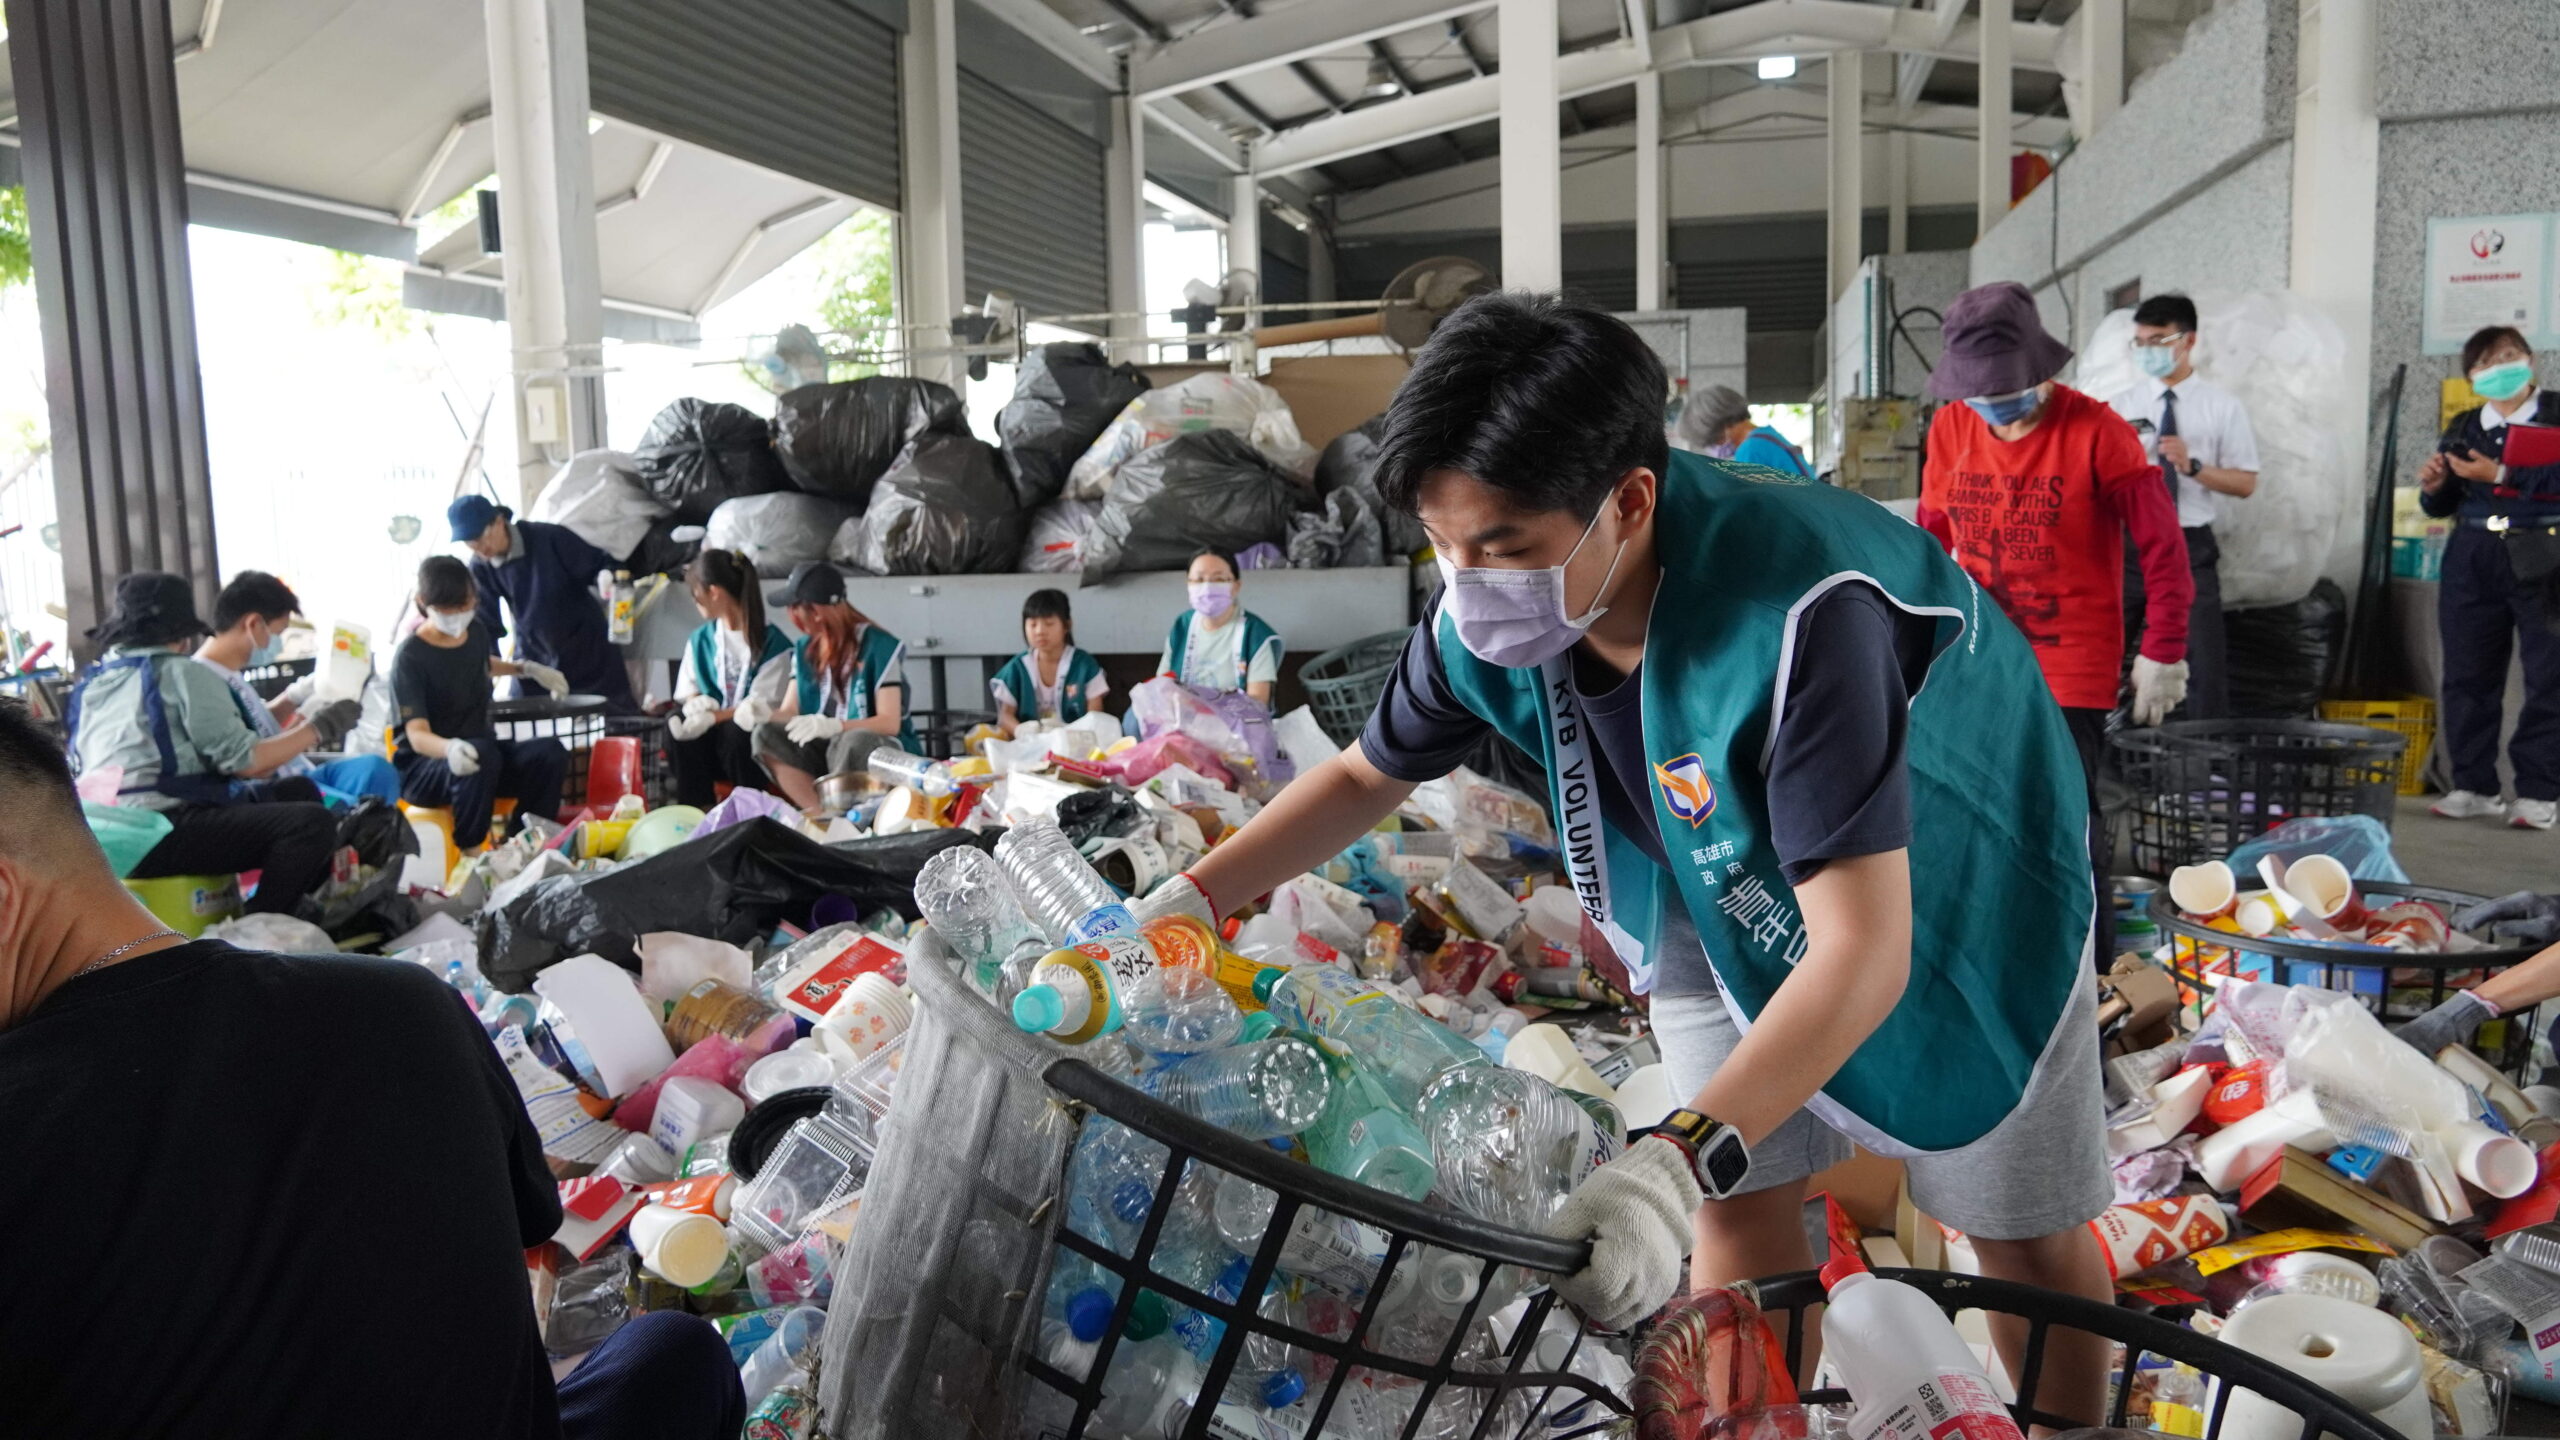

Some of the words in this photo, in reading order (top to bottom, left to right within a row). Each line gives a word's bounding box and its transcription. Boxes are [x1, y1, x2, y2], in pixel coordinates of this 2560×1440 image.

[1959, 471, 1995, 489] THINK
[2010, 492, 2046, 509] WITH
[2003, 527, 2039, 544] BEEN
[2009, 544, 2055, 561] SEVER
[1552, 680, 1578, 747] KYB
[1562, 757, 1605, 925] VOLUNTEER
[1690, 839, 1736, 867] 高雄市
